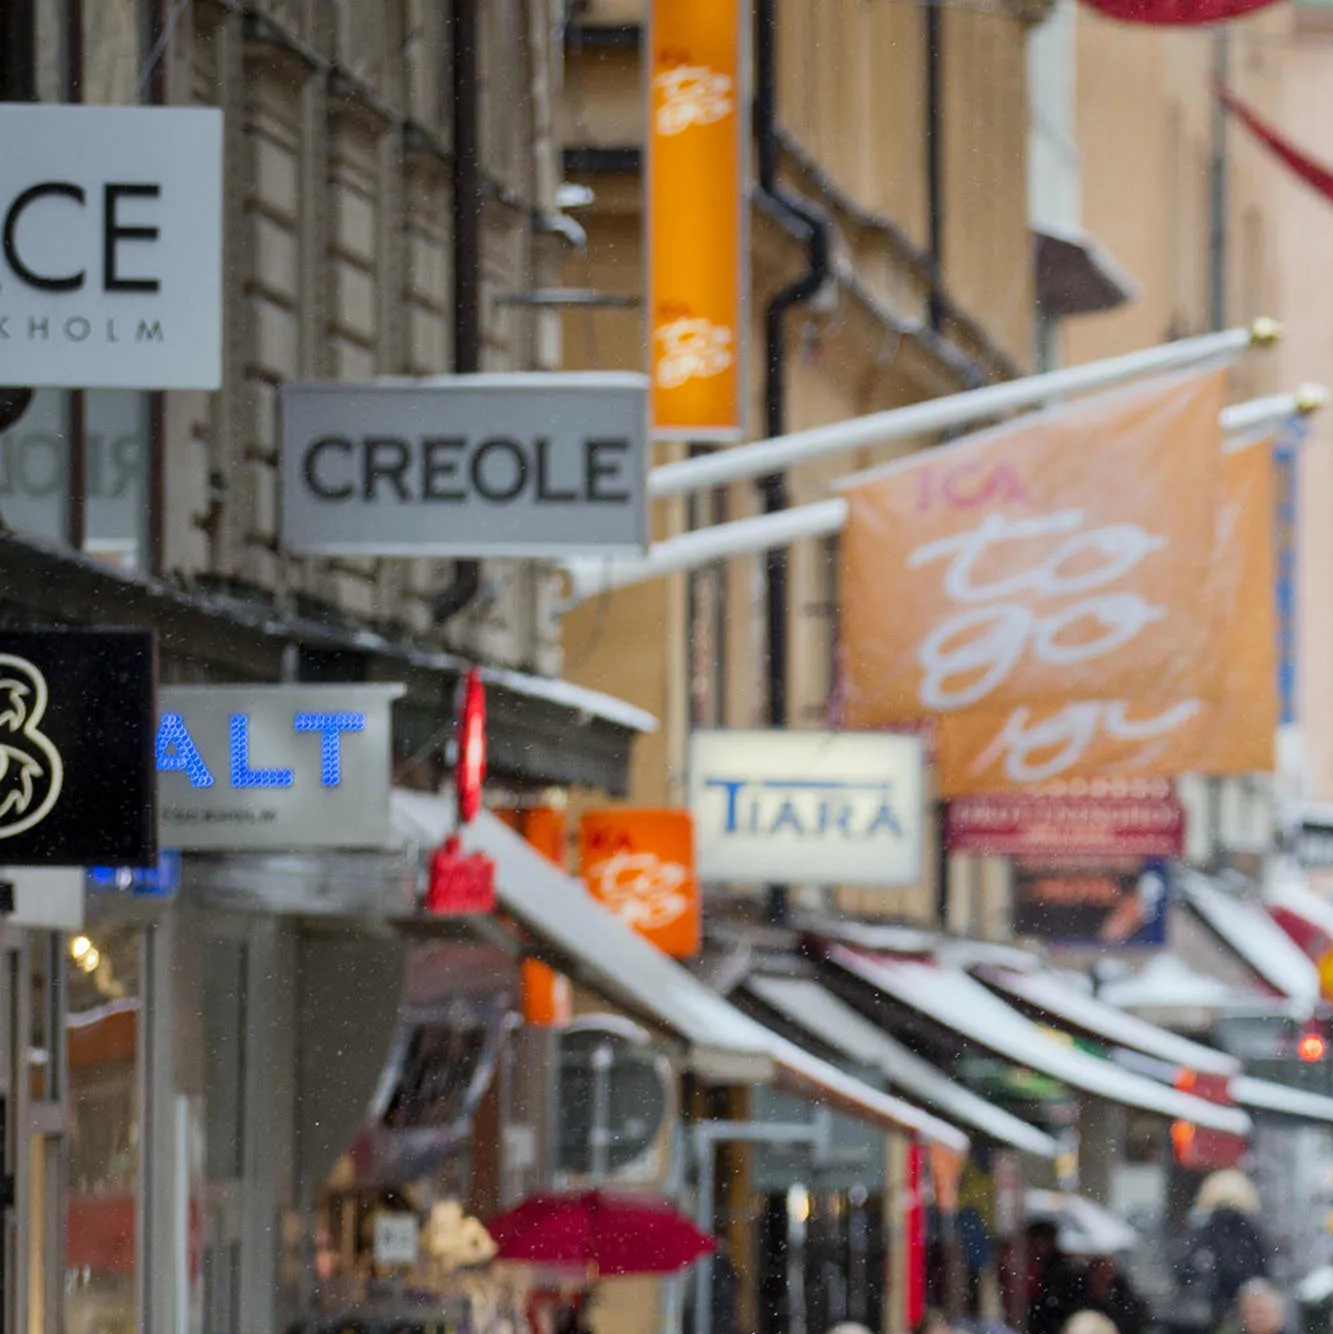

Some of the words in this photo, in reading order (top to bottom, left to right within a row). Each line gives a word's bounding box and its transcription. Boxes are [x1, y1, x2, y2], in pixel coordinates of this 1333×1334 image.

[302, 437, 631, 503] CREOLE
[916, 460, 1027, 512] ICA
[906, 507, 1170, 602] to
[917, 594, 1167, 711] go
[155, 712, 367, 788] ALT
